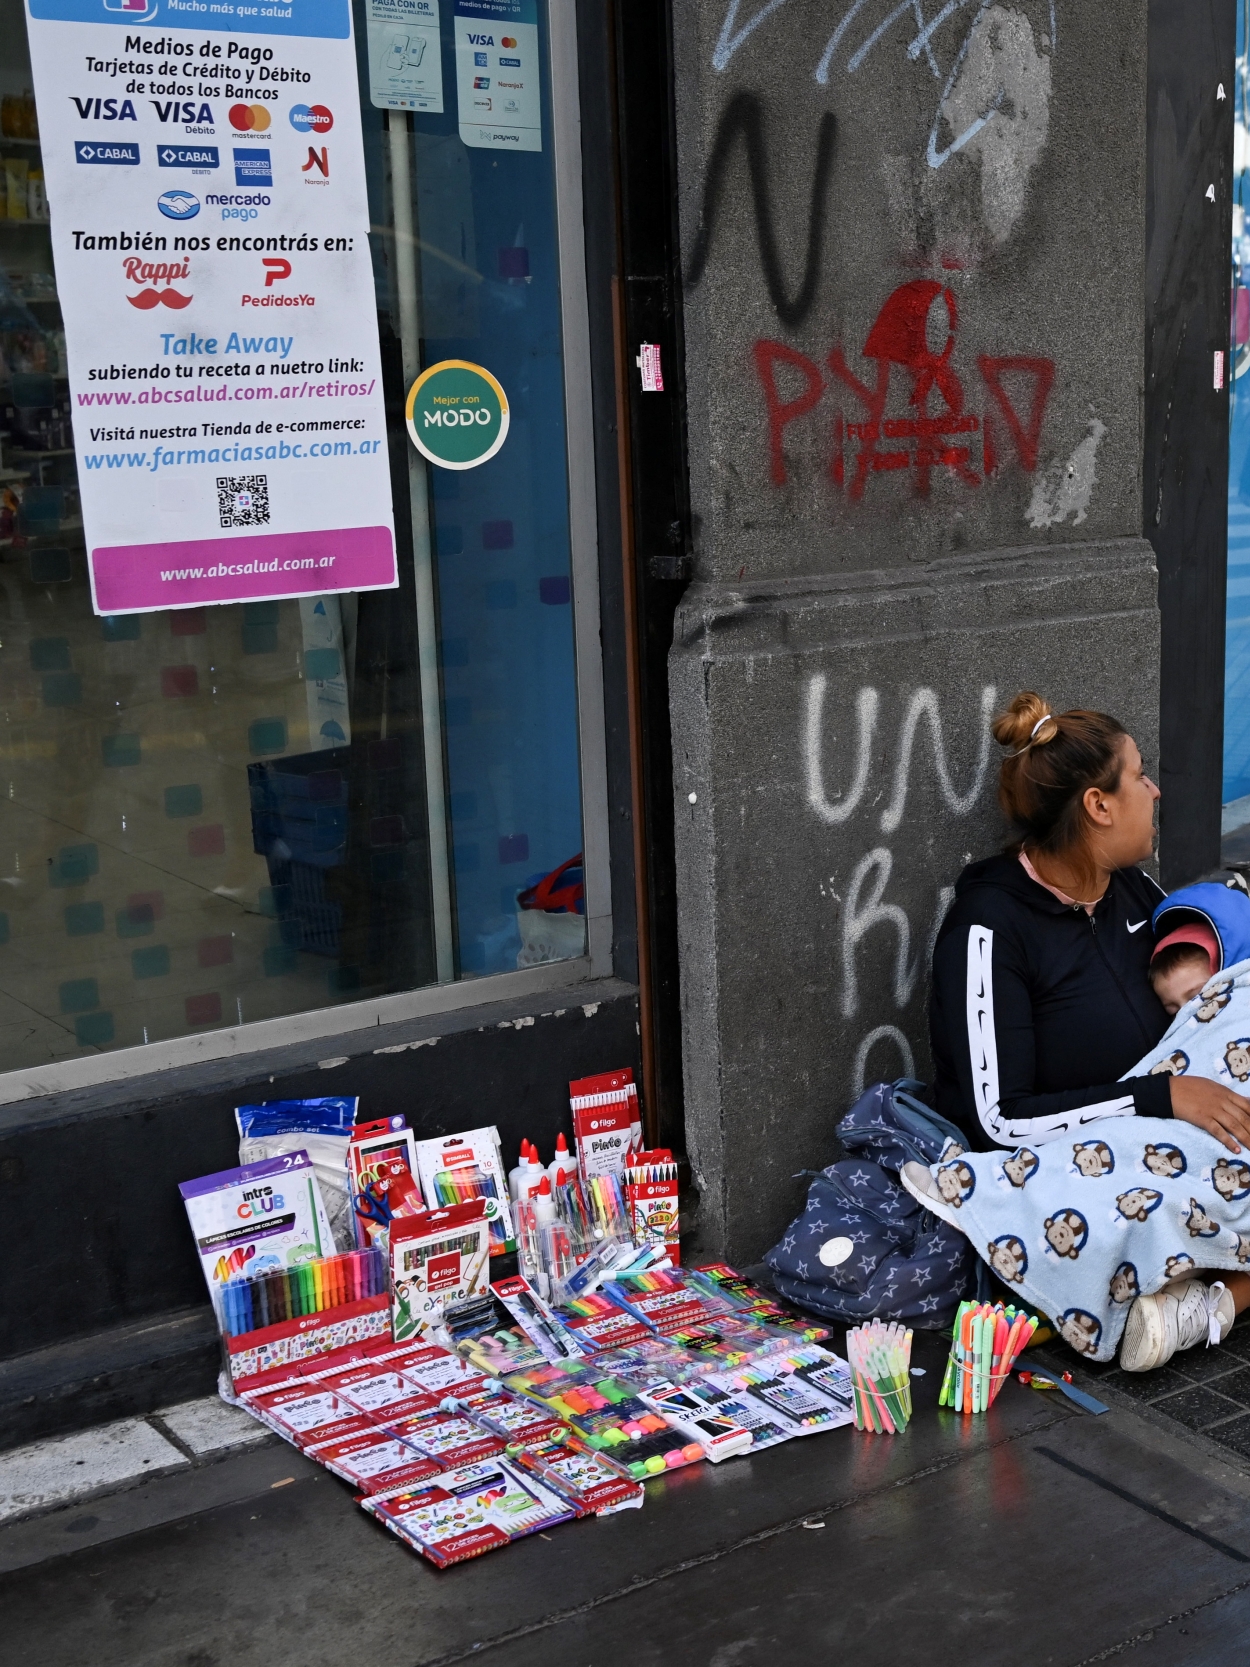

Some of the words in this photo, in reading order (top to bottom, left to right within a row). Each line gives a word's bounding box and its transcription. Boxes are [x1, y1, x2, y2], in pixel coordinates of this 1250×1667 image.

[168, 0, 207, 13] Mucho
[210, 2, 234, 14] más
[236, 6, 258, 17] que
[260, 6, 292, 18] salud
[398, 0, 415, 8] CON
[417, 2, 429, 10] QR
[466, 33, 495, 47] VISA
[125, 36, 194, 56] Medios
[199, 40, 222, 58] de
[227, 42, 273, 65] Pago
[85, 57, 153, 78] Tarjetas
[158, 61, 177, 76] de
[182, 62, 241, 79] Crédito
[246, 68, 254, 84] y
[259, 67, 311, 83] Débito
[126, 80, 145, 93] de
[150, 81, 194, 96] todos
[198, 83, 220, 97] los
[225, 84, 279, 100] Bancos
[68, 97, 137, 121] VISA
[149, 100, 214, 124] VISA
[294, 114, 329, 124] Maestro
[185, 126, 215, 136] Débito
[493, 134, 520, 142] payway
[97, 148, 136, 160] CABAL
[178, 151, 216, 163] CABAL
[205, 193, 271, 206] mercado
[221, 208, 258, 222] pago
[72, 231, 167, 251] También
[174, 237, 210, 251] nos
[217, 233, 318, 252] encontrás
[324, 238, 353, 252] en:
[122, 256, 191, 285] Rappi
[241, 294, 315, 307] PedidosYa
[160, 332, 217, 356] Take
[224, 334, 294, 358] Away
[88, 364, 171, 381] subiendo
[175, 364, 194, 378] tu
[198, 363, 251, 378] receta
[255, 365, 265, 376] a
[270, 361, 324, 375] nuetro
[328, 357, 364, 374] link:
[77, 379, 376, 407] www.abcsalud.com.ar/retiros/
[433, 396, 461, 407] Mejor
[463, 395, 480, 404] con
[424, 407, 491, 429] MODO
[90, 426, 135, 442] Visitá
[140, 426, 197, 440] nuestra
[201, 421, 250, 437] Tienda
[255, 420, 272, 435] de
[276, 417, 365, 434] e-commerce:
[84, 439, 381, 472] www.farmaciasabc.com.ar
[160, 554, 335, 582] www.abcsalud.com.ar
[277, 1126, 304, 1134] combo
[599, 1119, 616, 1127] filgo
[592, 1138, 622, 1153] Pinto
[283, 1154, 305, 1168] 24
[237, 1194, 285, 1219] CLUB
[648, 1201, 672, 1212] Pinto
[440, 1267, 456, 1277] filgo
[508, 1284, 524, 1292] filgo
[307, 1318, 321, 1326] filgo
[300, 1337, 325, 1349] Pinto
[413, 1354, 433, 1363] filgo
[283, 1392, 305, 1400] filgo
[679, 1405, 712, 1421] SKETCH
[416, 1419, 438, 1428] filgo
[349, 1441, 371, 1450] filgo
[453, 1465, 494, 1482] CLUB
[410, 1496, 432, 1506] filgo
